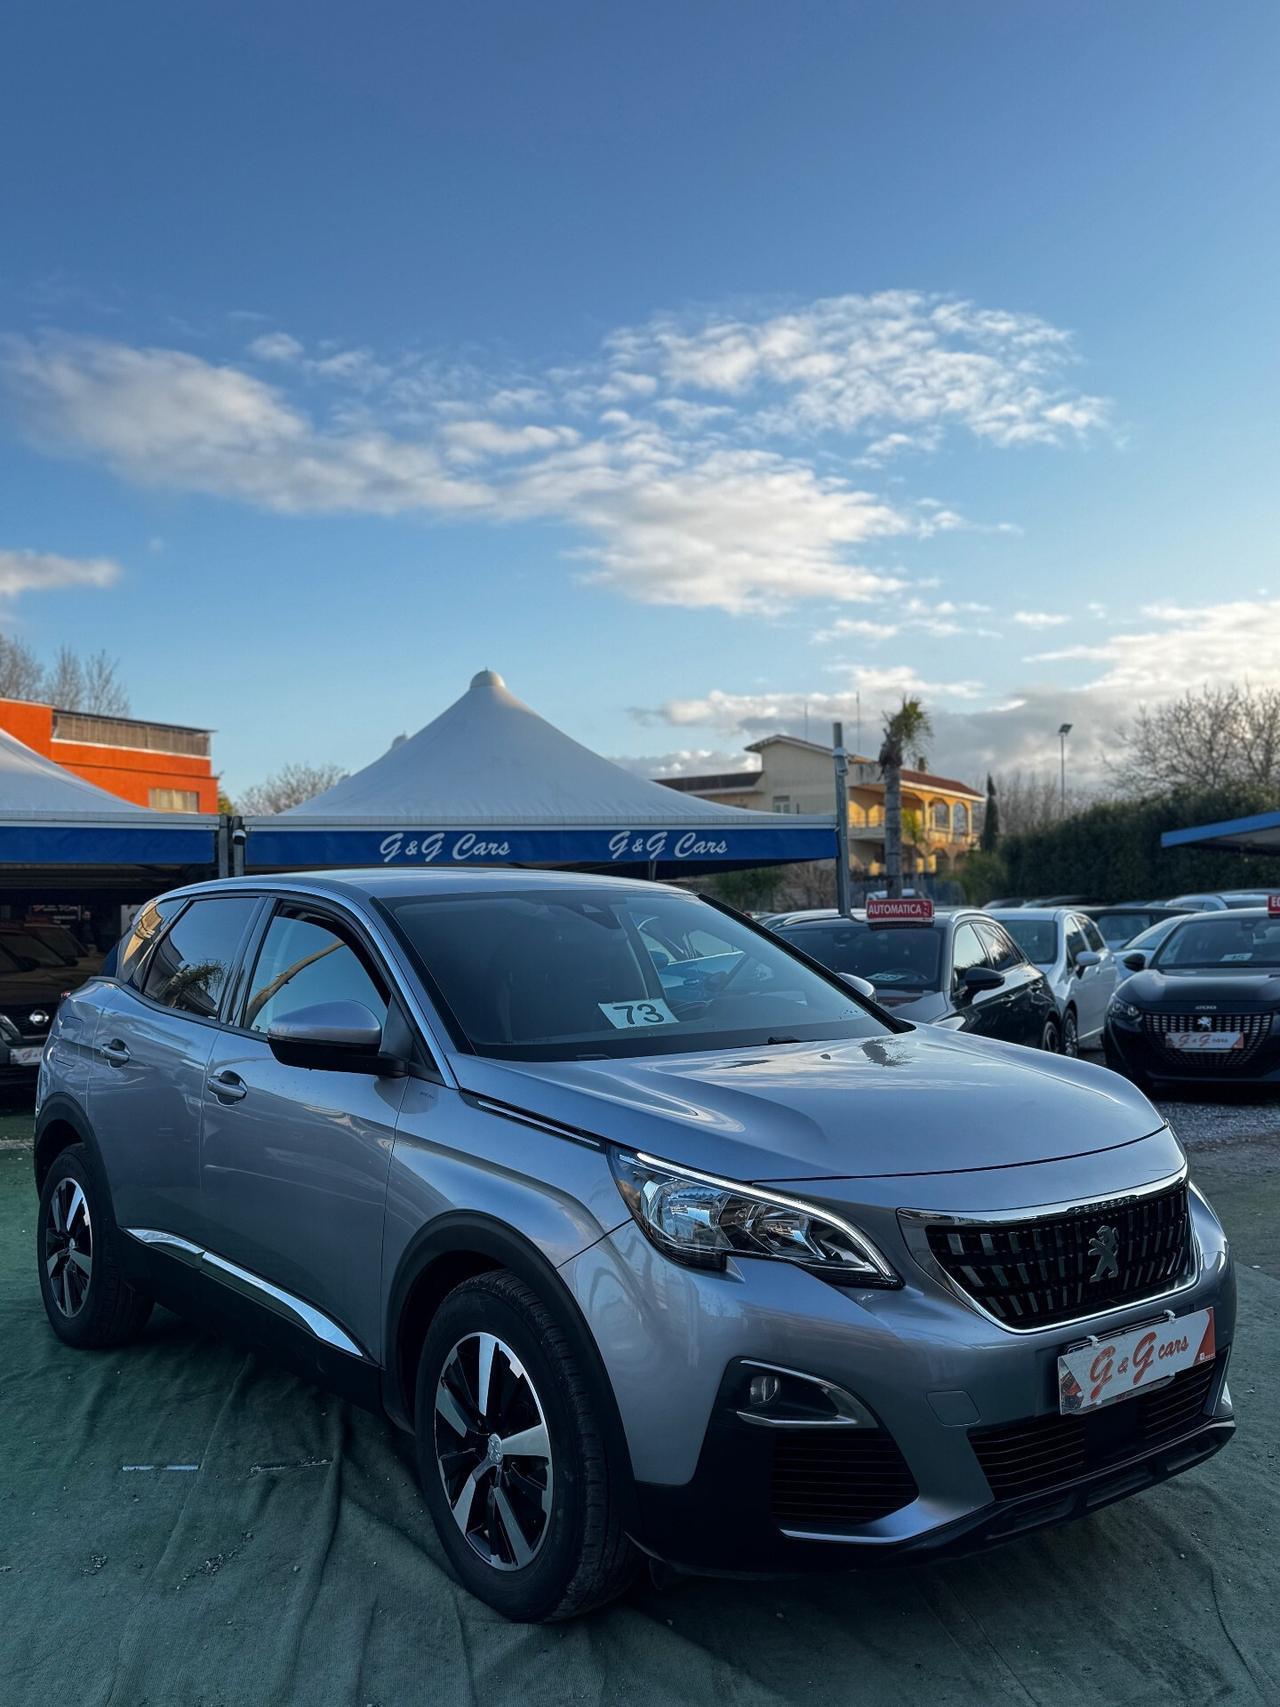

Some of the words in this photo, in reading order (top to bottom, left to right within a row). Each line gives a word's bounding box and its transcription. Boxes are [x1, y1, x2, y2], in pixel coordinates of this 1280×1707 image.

[452, 833, 510, 860] Cars
[674, 832, 728, 857] Cars
[868, 903, 922, 915] AUTOMATICA
[612, 1003, 665, 1025] 73
[1074, 1196, 1131, 1214] PEUGEOT
[1158, 1335, 1190, 1360] cars
